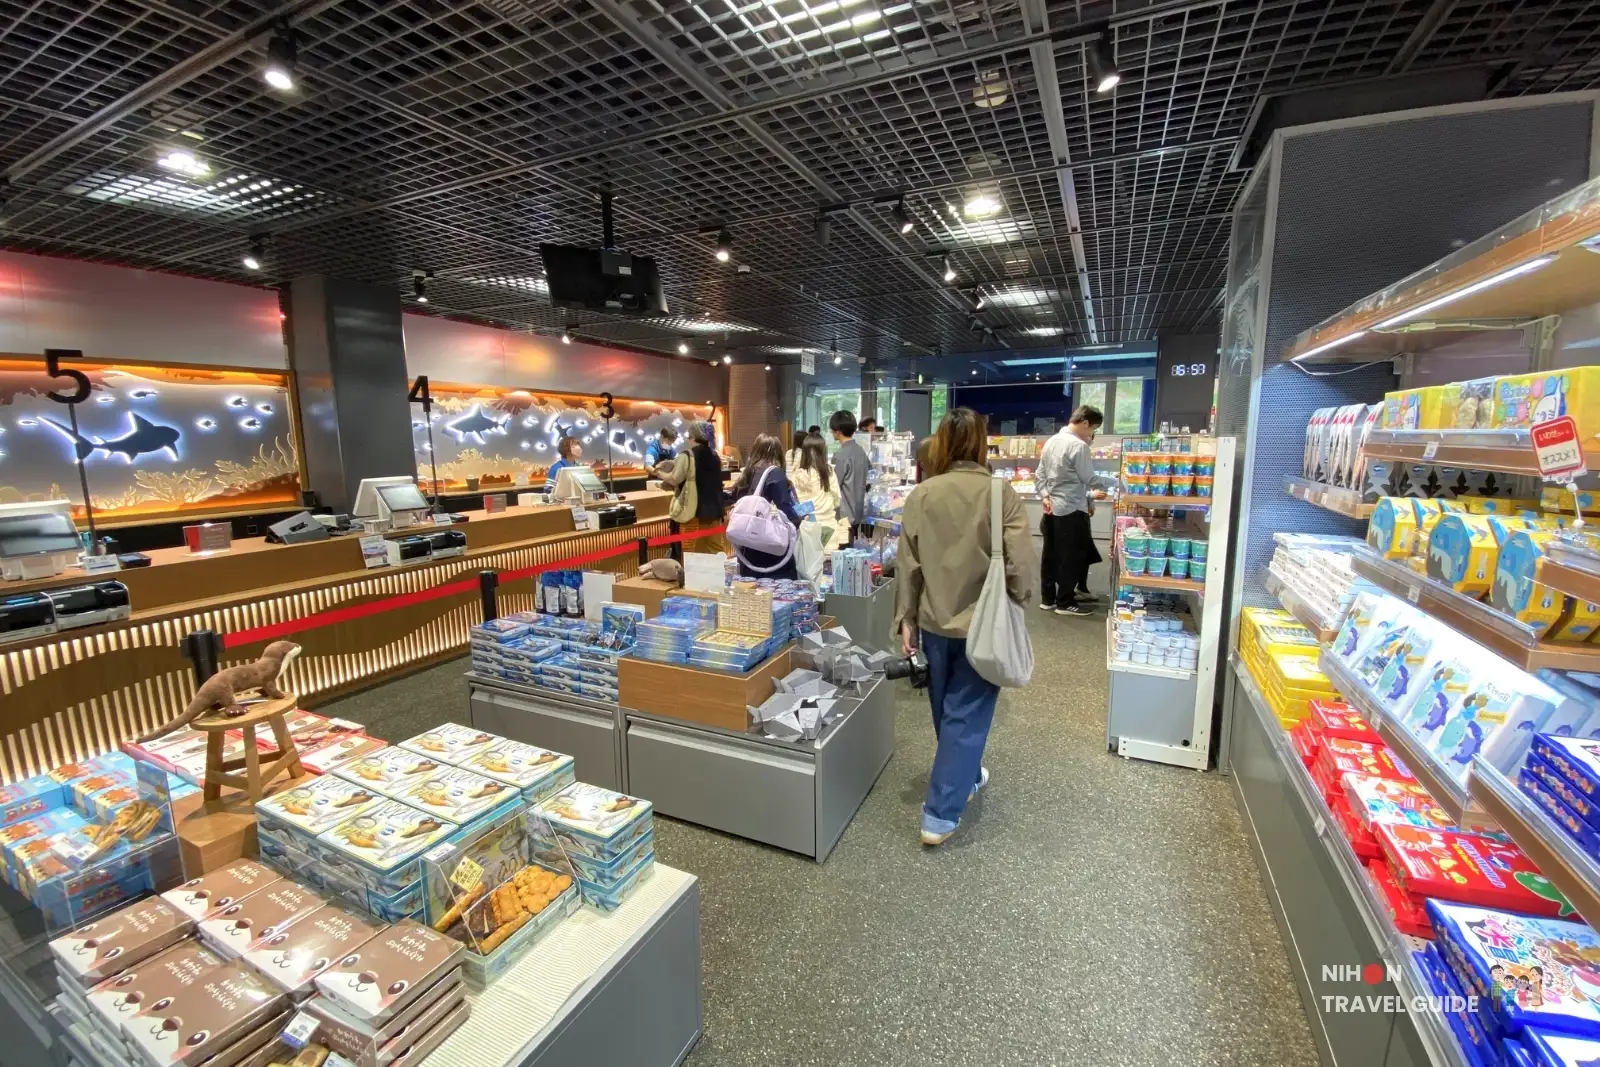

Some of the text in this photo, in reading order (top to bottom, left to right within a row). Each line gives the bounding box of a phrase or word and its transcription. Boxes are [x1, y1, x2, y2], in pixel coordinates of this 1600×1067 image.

[44, 348, 92, 404] 5
[407, 375, 434, 412] 4
[600, 391, 614, 419] 3
